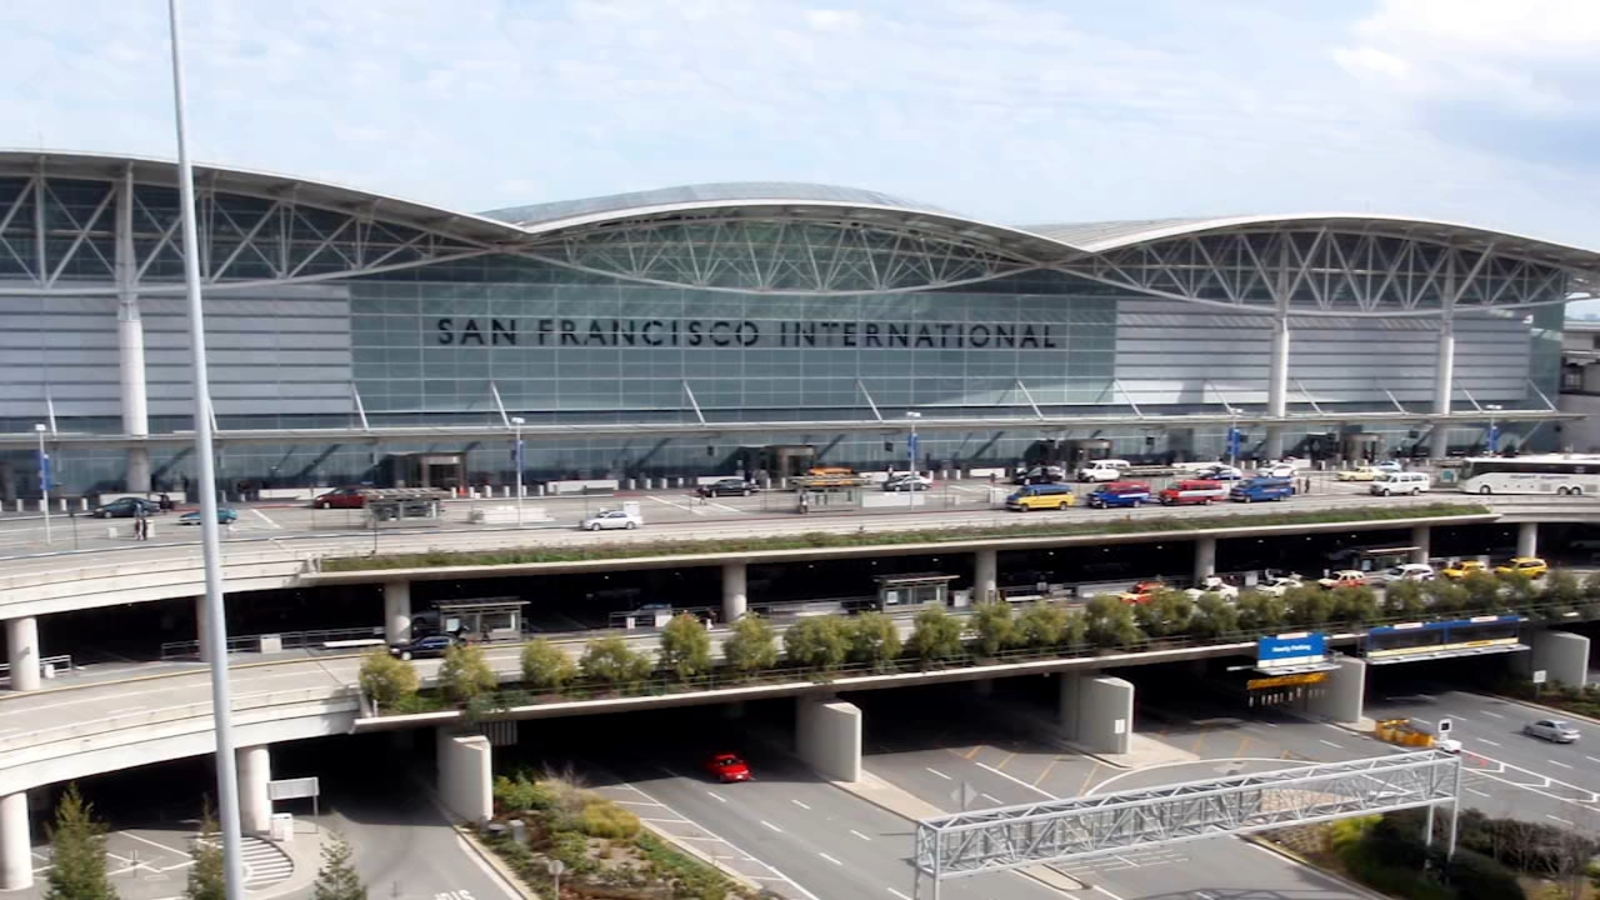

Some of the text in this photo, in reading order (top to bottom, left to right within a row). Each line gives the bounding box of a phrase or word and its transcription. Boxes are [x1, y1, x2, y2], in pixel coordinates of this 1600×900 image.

[437, 318, 1057, 348] SAN FRANCISCO INTERNATIONAL
